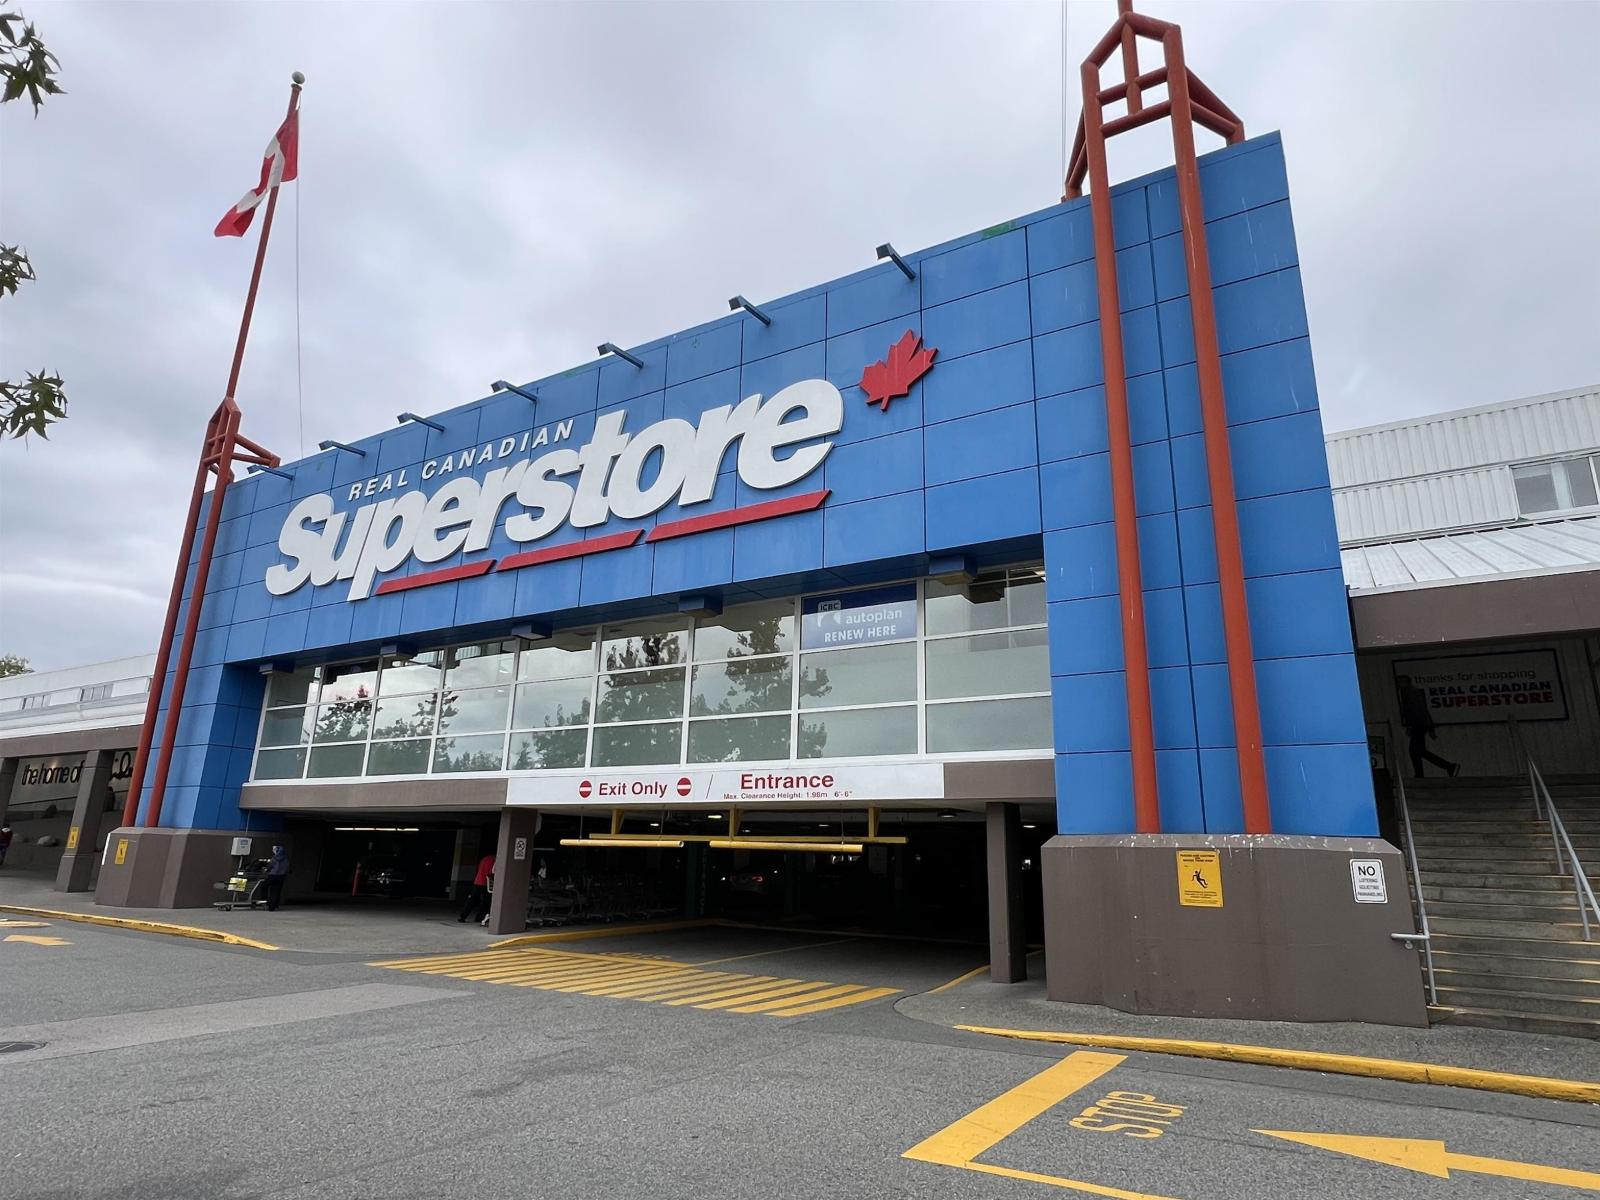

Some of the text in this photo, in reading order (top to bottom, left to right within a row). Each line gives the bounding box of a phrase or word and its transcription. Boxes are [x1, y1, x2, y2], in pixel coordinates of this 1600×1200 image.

[347, 419, 575, 501] REAL CANADIAN
[264, 378, 845, 601] Superstore
[820, 602, 839, 612] ICBC
[845, 608, 903, 624] autoplan
[824, 624, 898, 643] RENEW HERE
[1413, 668, 1537, 684] thanks for shopping
[1428, 680, 1553, 697] REAL CANADIAN
[1431, 690, 1555, 709] SUPERSTORE
[21, 763, 38, 786] the
[38, 763, 70, 785] home
[70, 759, 85, 784] of
[599, 781, 668, 799] Exit Only
[740, 773, 835, 790] Entrance
[740, 791, 776, 800] Clearance
[806, 790, 828, 799] 1.98m
[1357, 865, 1376, 877] NO
[1067, 1090, 1188, 1140] STOP
